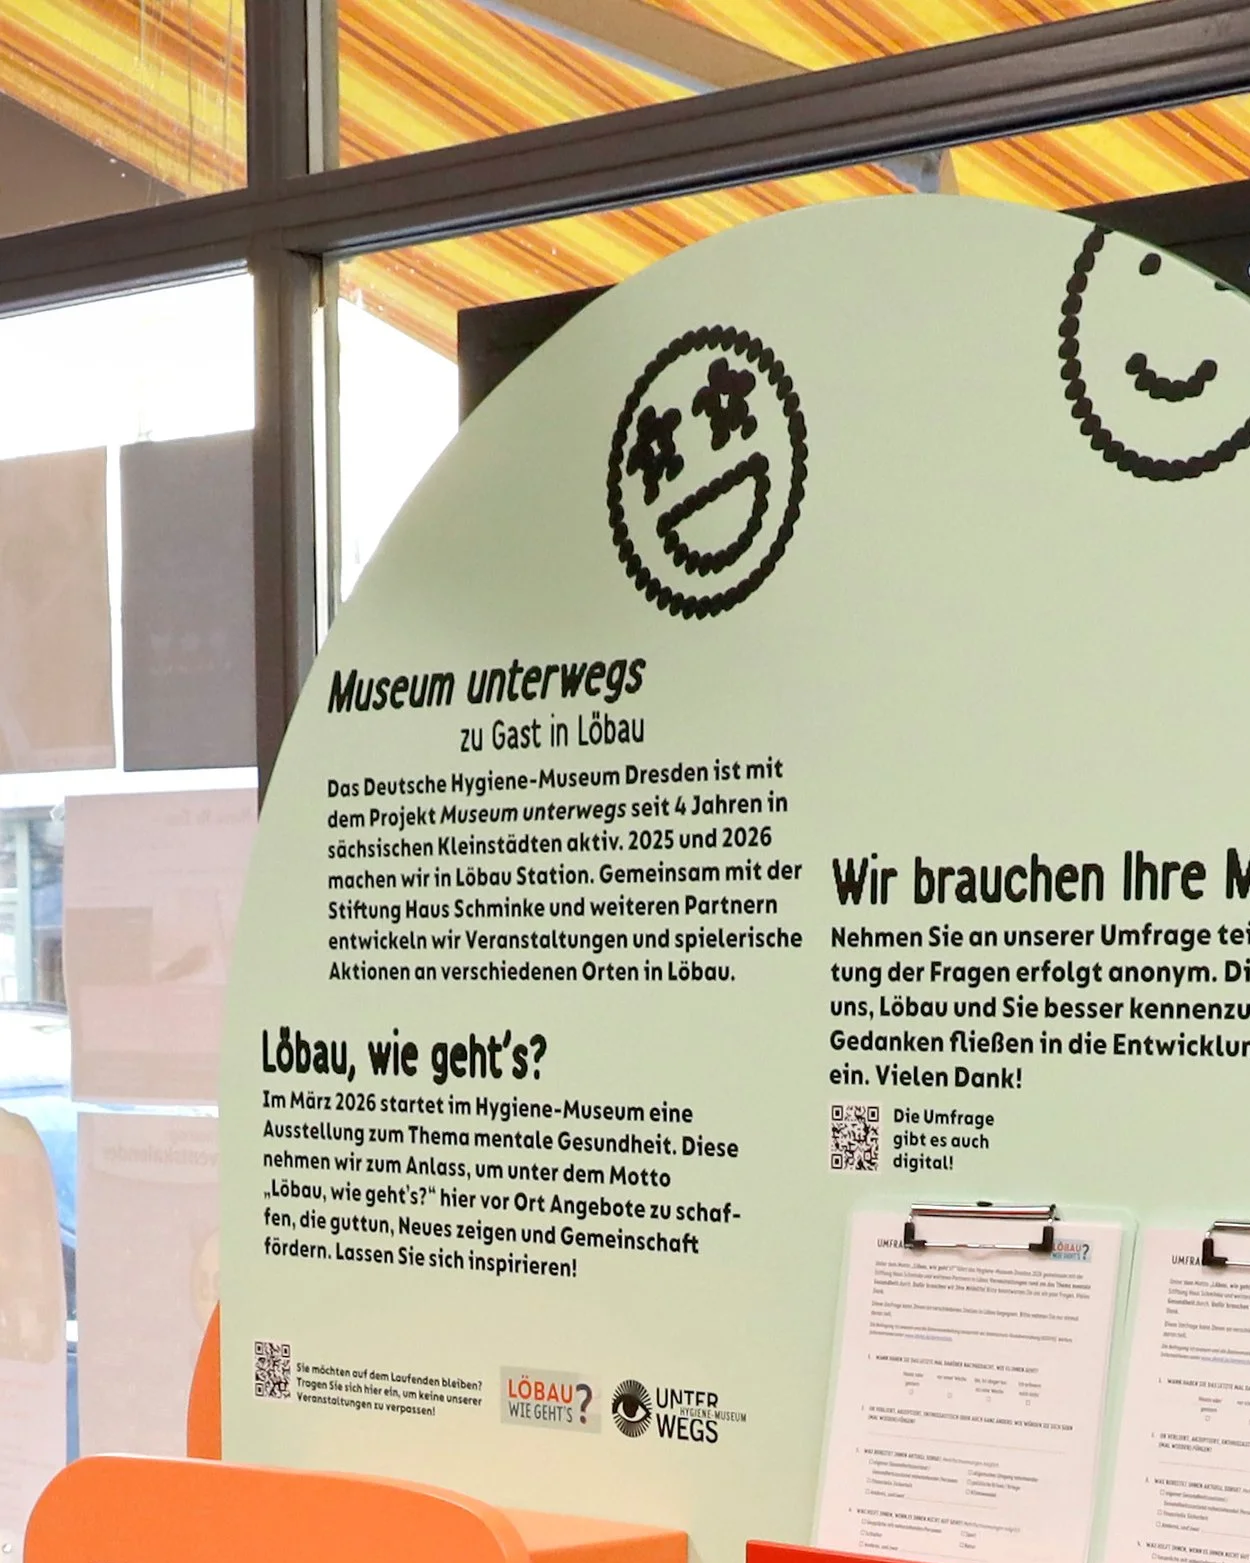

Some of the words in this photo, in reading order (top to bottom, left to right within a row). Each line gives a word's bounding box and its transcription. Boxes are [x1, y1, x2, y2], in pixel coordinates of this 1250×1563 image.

[327, 669, 455, 714] Museum
[467, 658, 647, 705] unterwegs
[460, 728, 483, 752] zu
[492, 718, 542, 751] Gast
[550, 713, 568, 748] in
[578, 710, 644, 746] Löbau
[328, 779, 359, 798] Das
[364, 774, 447, 796] Deutsche
[451, 768, 620, 797] Hygiene-Museum
[625, 762, 709, 785] Dresden
[713, 758, 741, 781] ist
[746, 756, 783, 780] mit
[327, 810, 365, 829] dem
[369, 805, 436, 832] Projekt
[439, 804, 518, 824] Museum
[522, 802, 627, 824] unterwegs
[631, 794, 670, 818] seit
[674, 795, 687, 816] 4
[691, 794, 762, 816] Jahren
[767, 790, 788, 812] in
[328, 869, 397, 889] machen
[400, 866, 430, 888] wir
[434, 866, 451, 887] in
[456, 866, 512, 887] Löbau
[516, 863, 594, 886] Station.
[599, 860, 720, 884] Gemeinsam
[725, 858, 762, 881] mit
[767, 859, 802, 881] der
[832, 852, 898, 906] Wir
[914, 852, 1104, 905] brauchen
[1123, 850, 1206, 901] Ihre
[831, 926, 923, 948] Nehmen
[928, 923, 964, 947] Sie
[969, 930, 998, 947] an
[1004, 929, 1095, 947] unserer
[1100, 922, 1212, 952] Umfrage
[329, 960, 410, 980] Aktionen
[414, 966, 437, 980] an
[441, 959, 577, 981] verschiedenen
[582, 961, 639, 981] Orten
[643, 959, 663, 981] in
[668, 960, 735, 981] Löbau.
[262, 1025, 356, 1083] Löbau,
[367, 1027, 419, 1077] wie
[431, 1029, 547, 1086] geht's?
[829, 1062, 870, 1086] ein.
[875, 1063, 948, 1087] Vielen
[954, 1066, 1022, 1089] Dank!
[263, 1090, 286, 1109] Im
[290, 1091, 332, 1110] März
[335, 1092, 376, 1112] 2026
[380, 1095, 444, 1114] startet
[448, 1094, 471, 1115] im
[476, 1096, 645, 1122] Hygiene-Museum
[649, 1100, 693, 1123] eine
[894, 1107, 920, 1124] Die
[923, 1109, 995, 1130] Umfrage
[263, 1119, 364, 1147] Ausstellung
[368, 1128, 404, 1144] zum
[408, 1125, 470, 1146] Thema
[474, 1130, 553, 1150] mentale
[557, 1131, 677, 1155] Gesundheit.
[682, 1134, 739, 1158] Diese
[893, 1129, 926, 1150] gibt
[930, 1135, 947, 1148] es
[951, 1133, 989, 1149] auch
[893, 1152, 953, 1173] digital!
[330, 1181, 362, 1202] wie
[440, 1186, 476, 1208] hier
[480, 1194, 510, 1210] vor
[514, 1192, 545, 1213] Ort
[549, 1194, 646, 1221] Angebote
[650, 1204, 671, 1220] zu
[676, 1201, 741, 1223] schaf-
[264, 1236, 332, 1259] fördern.
[336, 1242, 394, 1264] Lassen
[398, 1245, 425, 1266] Sie
[429, 1247, 464, 1269] sich
[468, 1249, 577, 1278] inspirieren!
[877, 1239, 902, 1249] UMFRA
[1171, 1255, 1201, 1266] UMFRA
[296, 1362, 310, 1373] Sie
[311, 1364, 351, 1378] möchten
[352, 1368, 368, 1380] auf
[369, 1370, 390, 1382] dem
[390, 1371, 440, 1387] Laufenden
[441, 1377, 483, 1391] bleiben?
[296, 1376, 328, 1391] Tragen
[329, 1380, 343, 1392] Sie
[344, 1381, 363, 1394] sich
[363, 1383, 383, 1396] hier
[383, 1385, 401, 1400] ein,
[402, 1390, 417, 1399] um
[418, 1389, 445, 1403] keine
[446, 1394, 482, 1406] unserer
[508, 1374, 573, 1404] LÖBAU
[296, 1391, 372, 1411] Veranstaltungen
[374, 1402, 384, 1411] zu
[385, 1403, 436, 1416] verpassen!
[508, 1402, 531, 1419] WIE
[534, 1403, 573, 1423] GEHT'S
[656, 1387, 719, 1410] UNTER
[656, 1413, 719, 1444] WEGS
[679, 1407, 747, 1423] HYGIENE-MUSEUM
